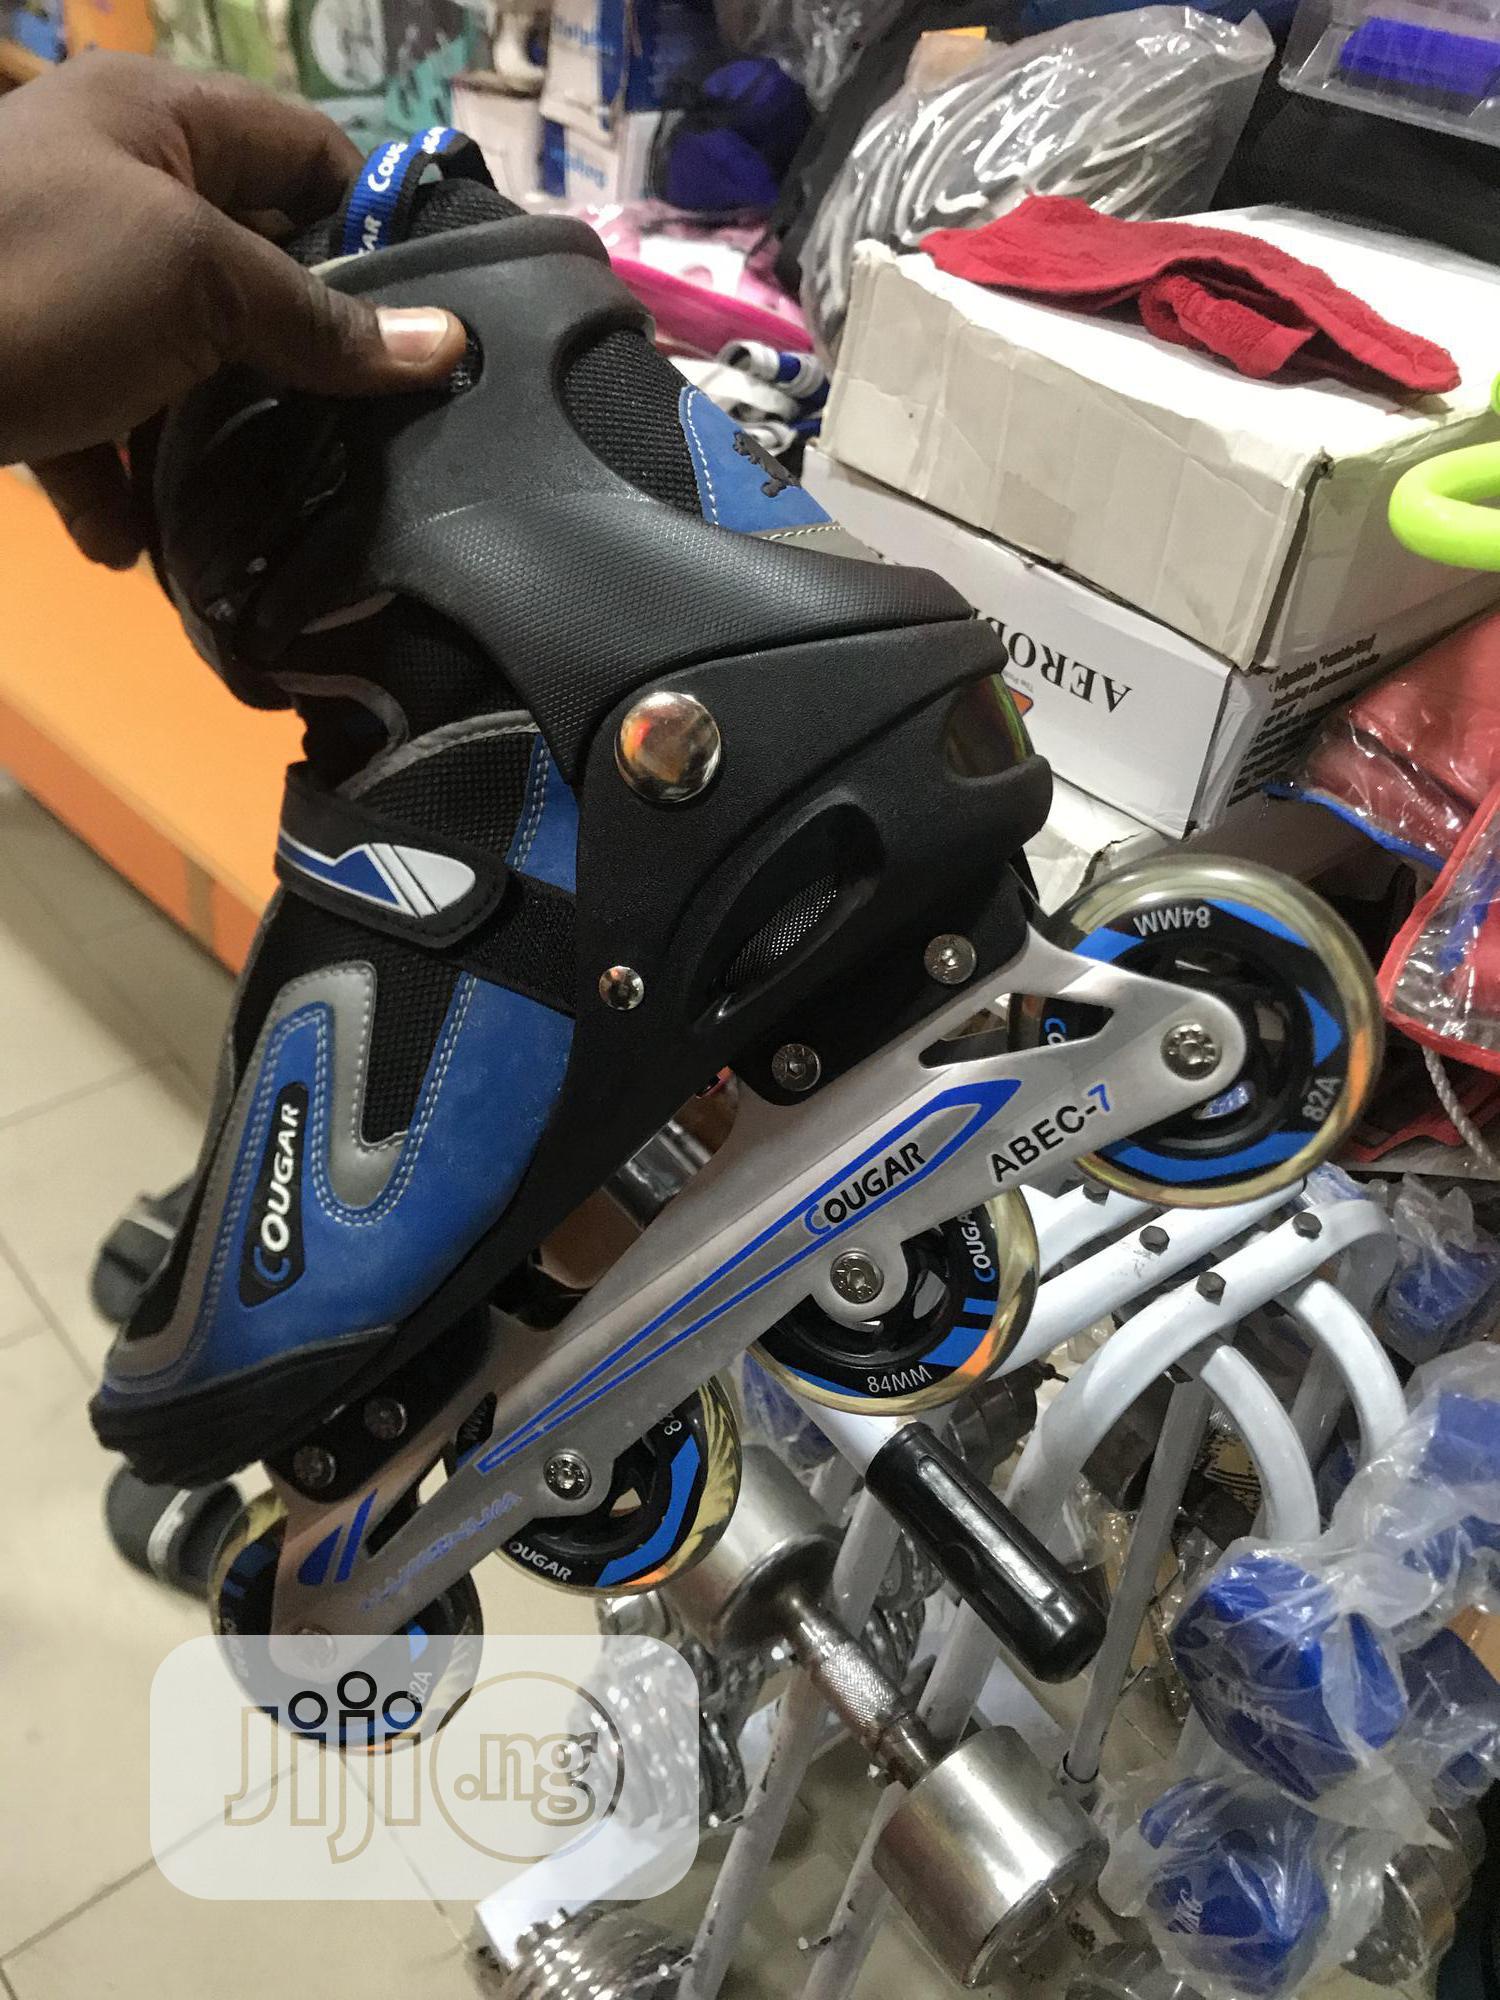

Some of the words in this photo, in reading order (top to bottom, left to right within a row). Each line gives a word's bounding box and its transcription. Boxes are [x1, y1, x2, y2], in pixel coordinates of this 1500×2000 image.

[972, 607, 1133, 713] AERO
[1133, 906, 1211, 936] 84MM
[991, 1083, 1111, 1183] ABEC-7
[1302, 1076, 1341, 1122] 82A
[253, 1102, 300, 1283] COUGAR
[804, 1142, 927, 1236] COUGAR
[957, 1210, 997, 1283] COUGA
[867, 1364, 933, 1394] 84MM
[508, 1541, 573, 1581] OUGAR
